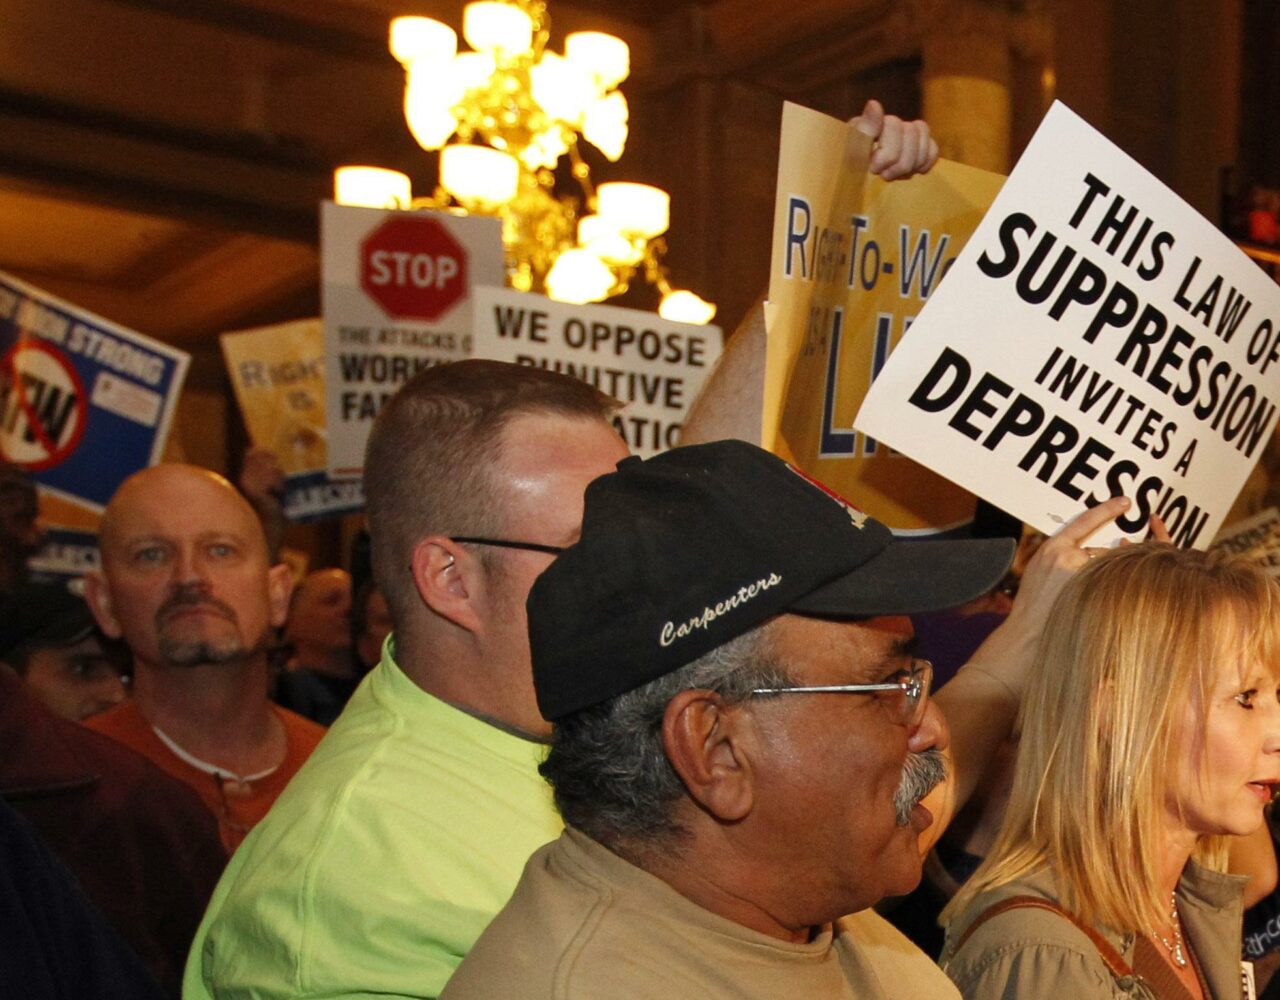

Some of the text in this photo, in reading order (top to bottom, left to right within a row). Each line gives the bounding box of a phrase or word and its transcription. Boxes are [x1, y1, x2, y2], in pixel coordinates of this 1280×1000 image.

[370, 251, 458, 290] STOP
[1068, 172, 1175, 281] THIS
[1173, 256, 1251, 344] LAW
[338, 326, 371, 344] THE
[339, 354, 450, 384] WORK
[494, 304, 705, 367] WE OPPOSE
[976, 211, 1276, 458] SUPPRESSION
[908, 346, 1209, 548] DEPRESSION
[1035, 346, 1198, 477] INVITES A
[659, 572, 782, 648] Carpenters
